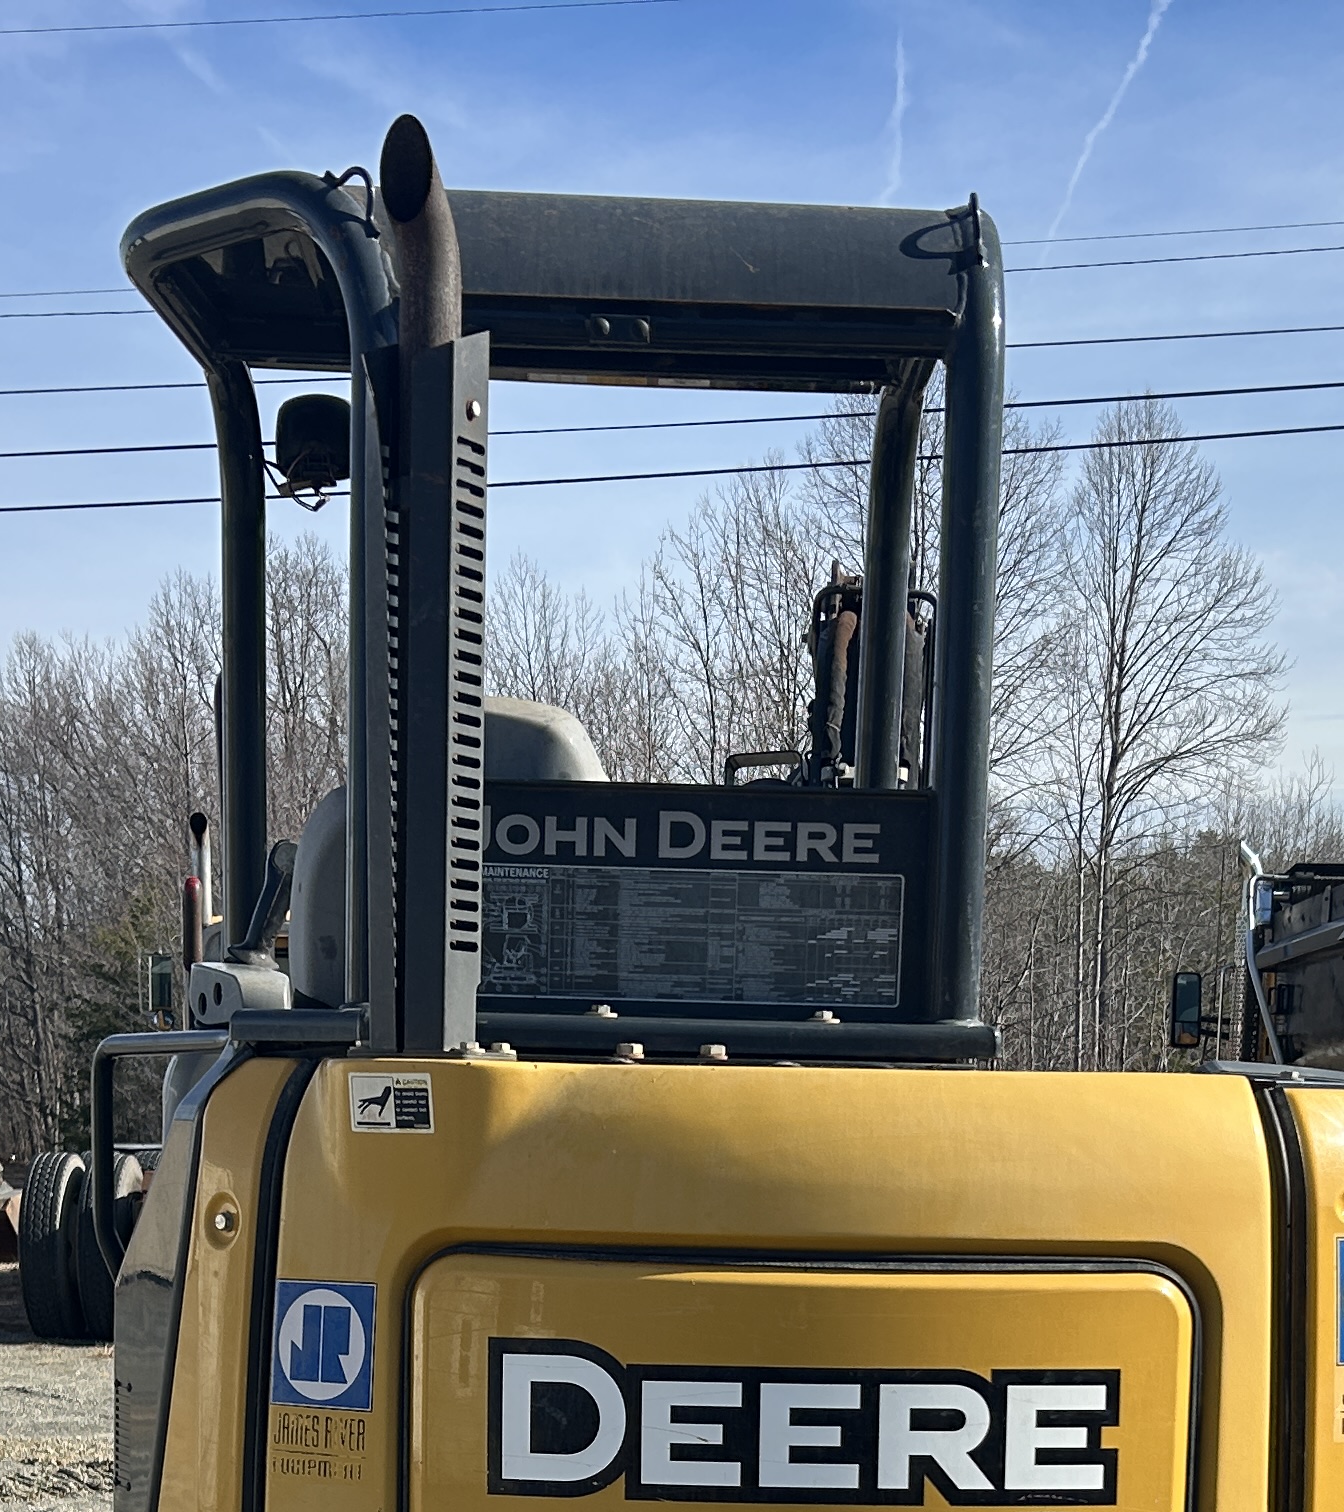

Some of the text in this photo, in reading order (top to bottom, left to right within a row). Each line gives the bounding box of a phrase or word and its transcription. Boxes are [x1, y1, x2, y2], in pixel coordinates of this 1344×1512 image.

[658, 810, 881, 865] DEERE
[273, 1412, 366, 1452] JAMES RVER
[502, 1353, 1108, 1491] DEERE
[272, 1456, 362, 1481] QUIPMN
